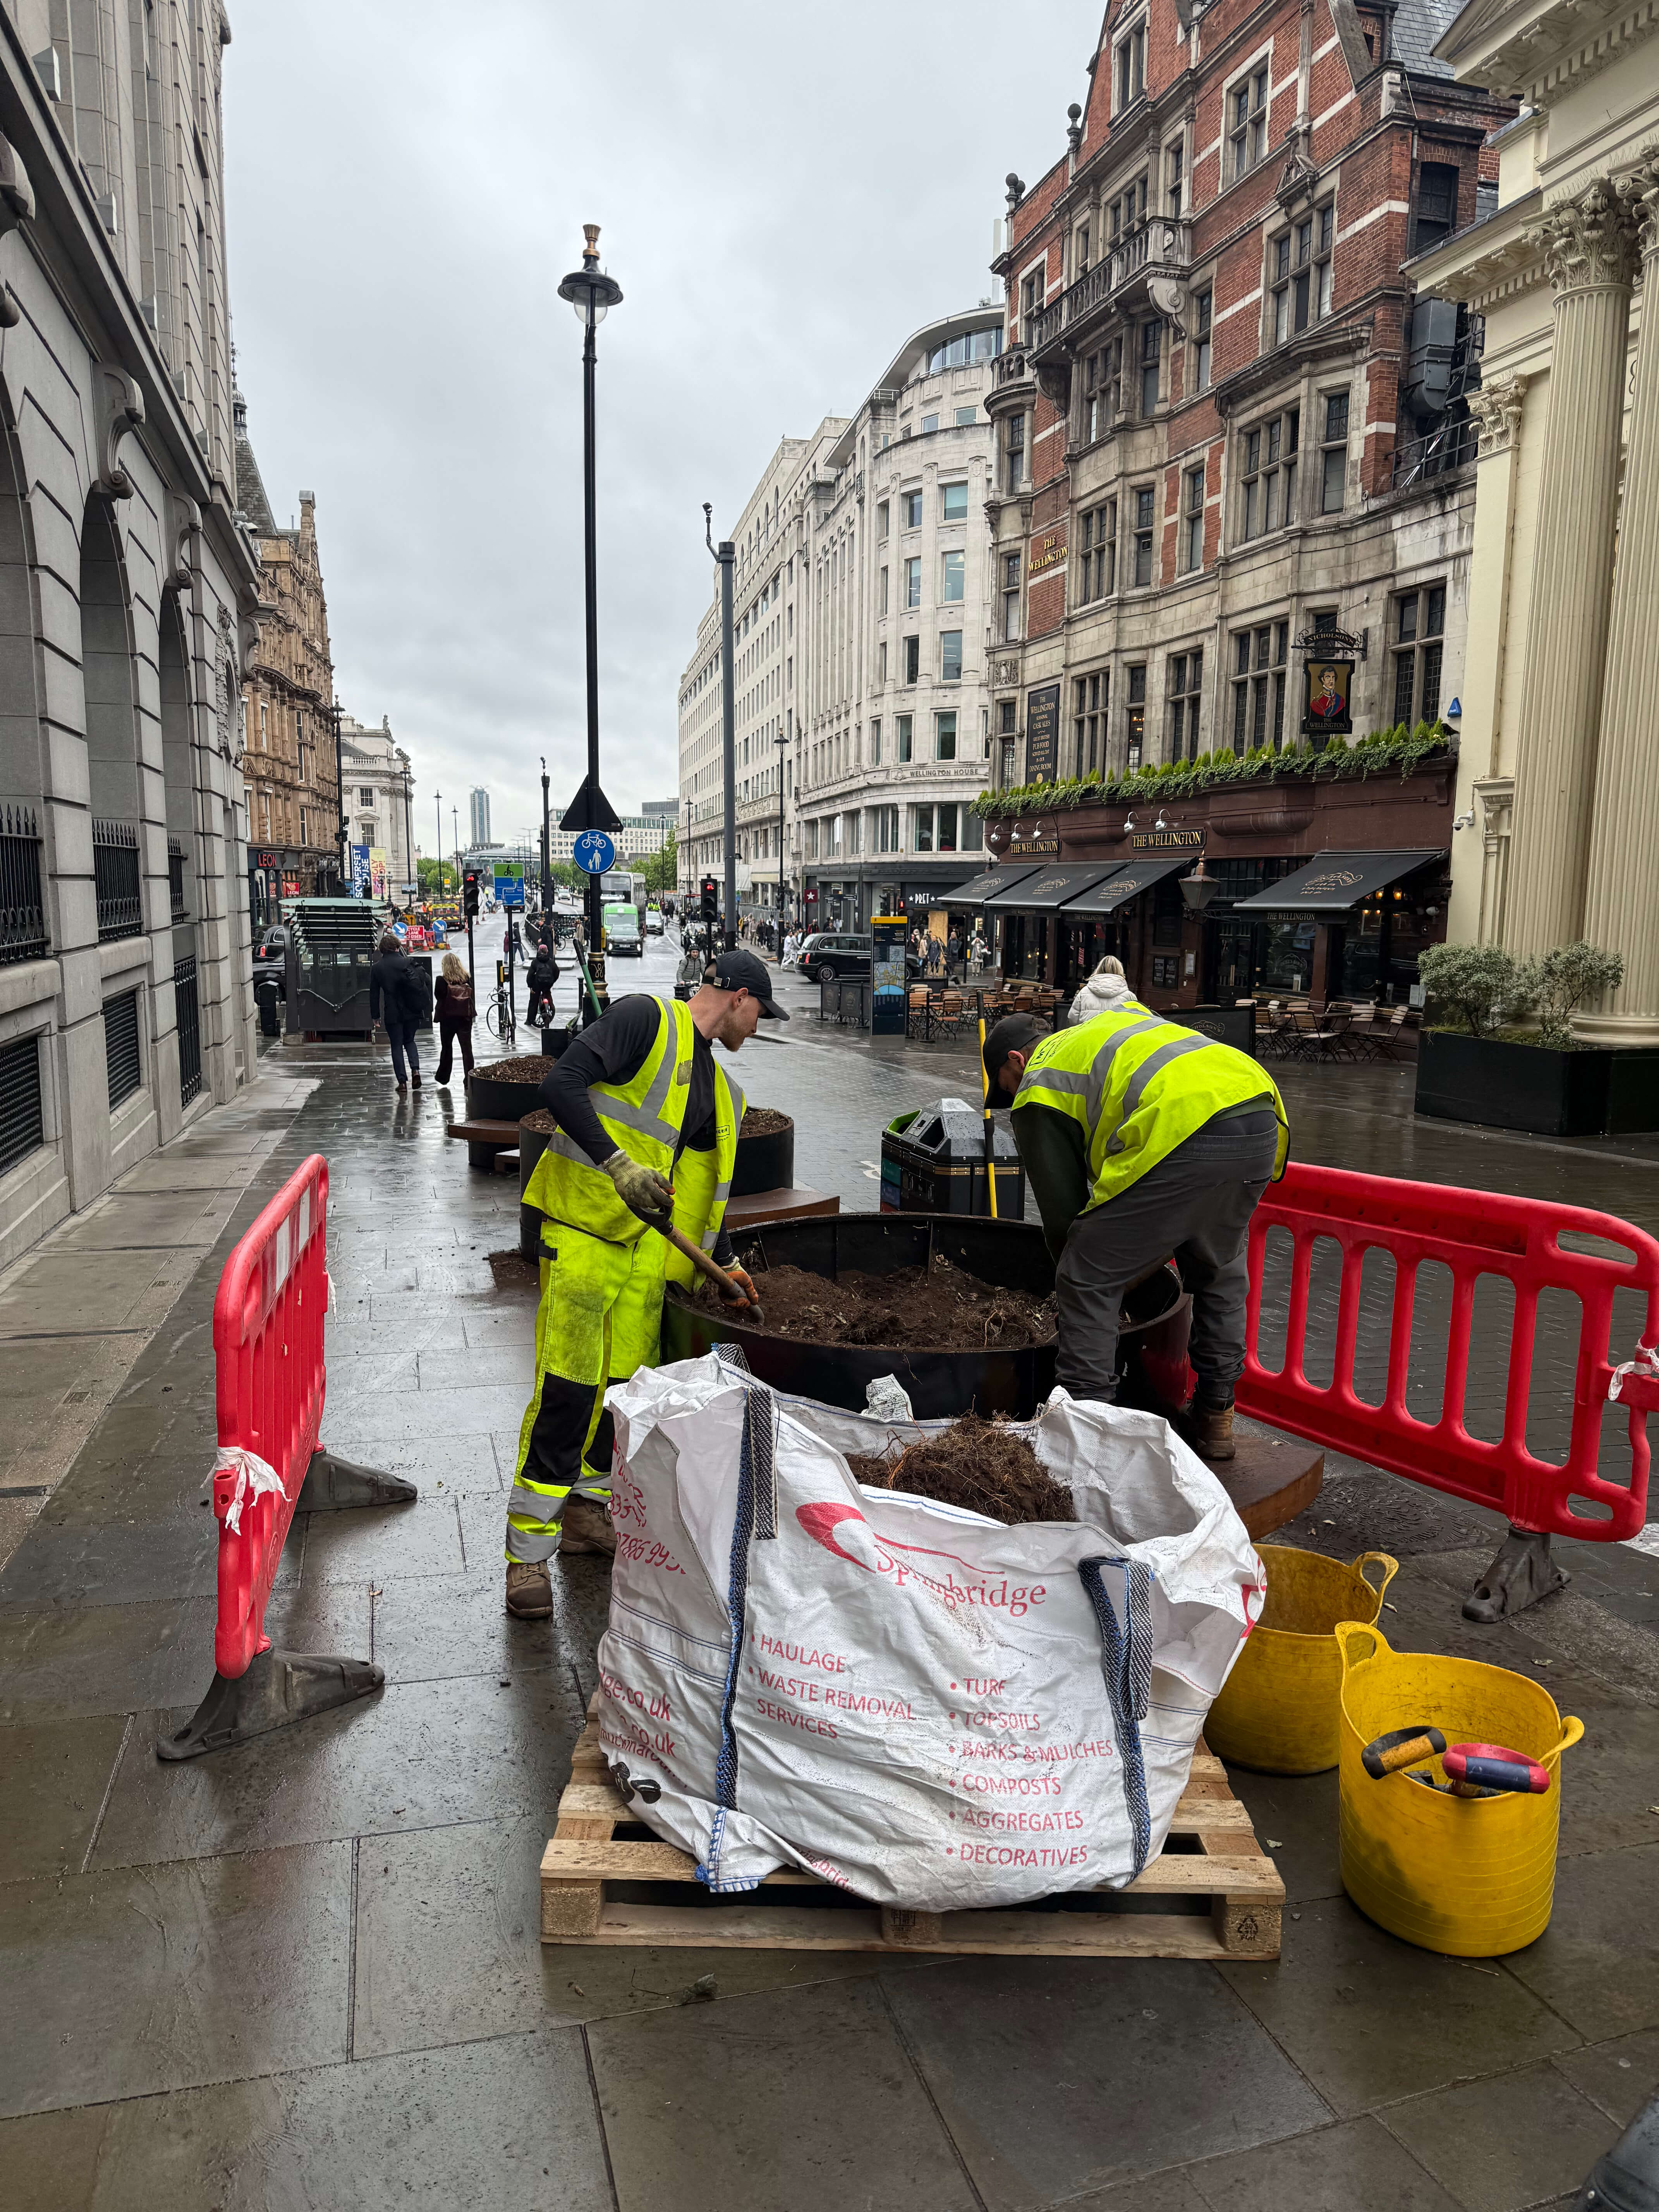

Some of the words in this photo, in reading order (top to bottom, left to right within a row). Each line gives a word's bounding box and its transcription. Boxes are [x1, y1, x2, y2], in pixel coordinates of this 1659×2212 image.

[1044, 536, 1056, 550] THE
[1029, 546, 1068, 572] WELLINGTON
[1030, 702, 1055, 714] WELLINGTON
[1010, 843, 1021, 853] THE
[1022, 840, 1058, 852] WELLINGTON
[1133, 835, 1147, 847] THE
[1148, 831, 1202, 846] WELLINGTON
[258, 853, 276, 867] LEON
[353, 848, 363, 898] SOMERSET
[915, 893, 930, 904] PRET
[1278, 912, 1316, 921] WELLINGTON
[760, 1634, 847, 1673] HAULAGE
[758, 1666, 819, 1702] WASTE
[824, 1688, 916, 1720] REMOVAL
[963, 1678, 1007, 1696] TURF
[757, 1698, 838, 1739] SERVICES
[965, 1711, 1040, 1731] TOPSOILS
[962, 1741, 1017, 1762] BARKS
[1023, 1745, 1037, 1762] &
[1037, 1740, 1113, 1762] MULCHES
[963, 1774, 1061, 1795] COMPOSTS
[962, 1808, 1084, 1832] AGGREGATES
[960, 1842, 1087, 1867] DECORATIVES
